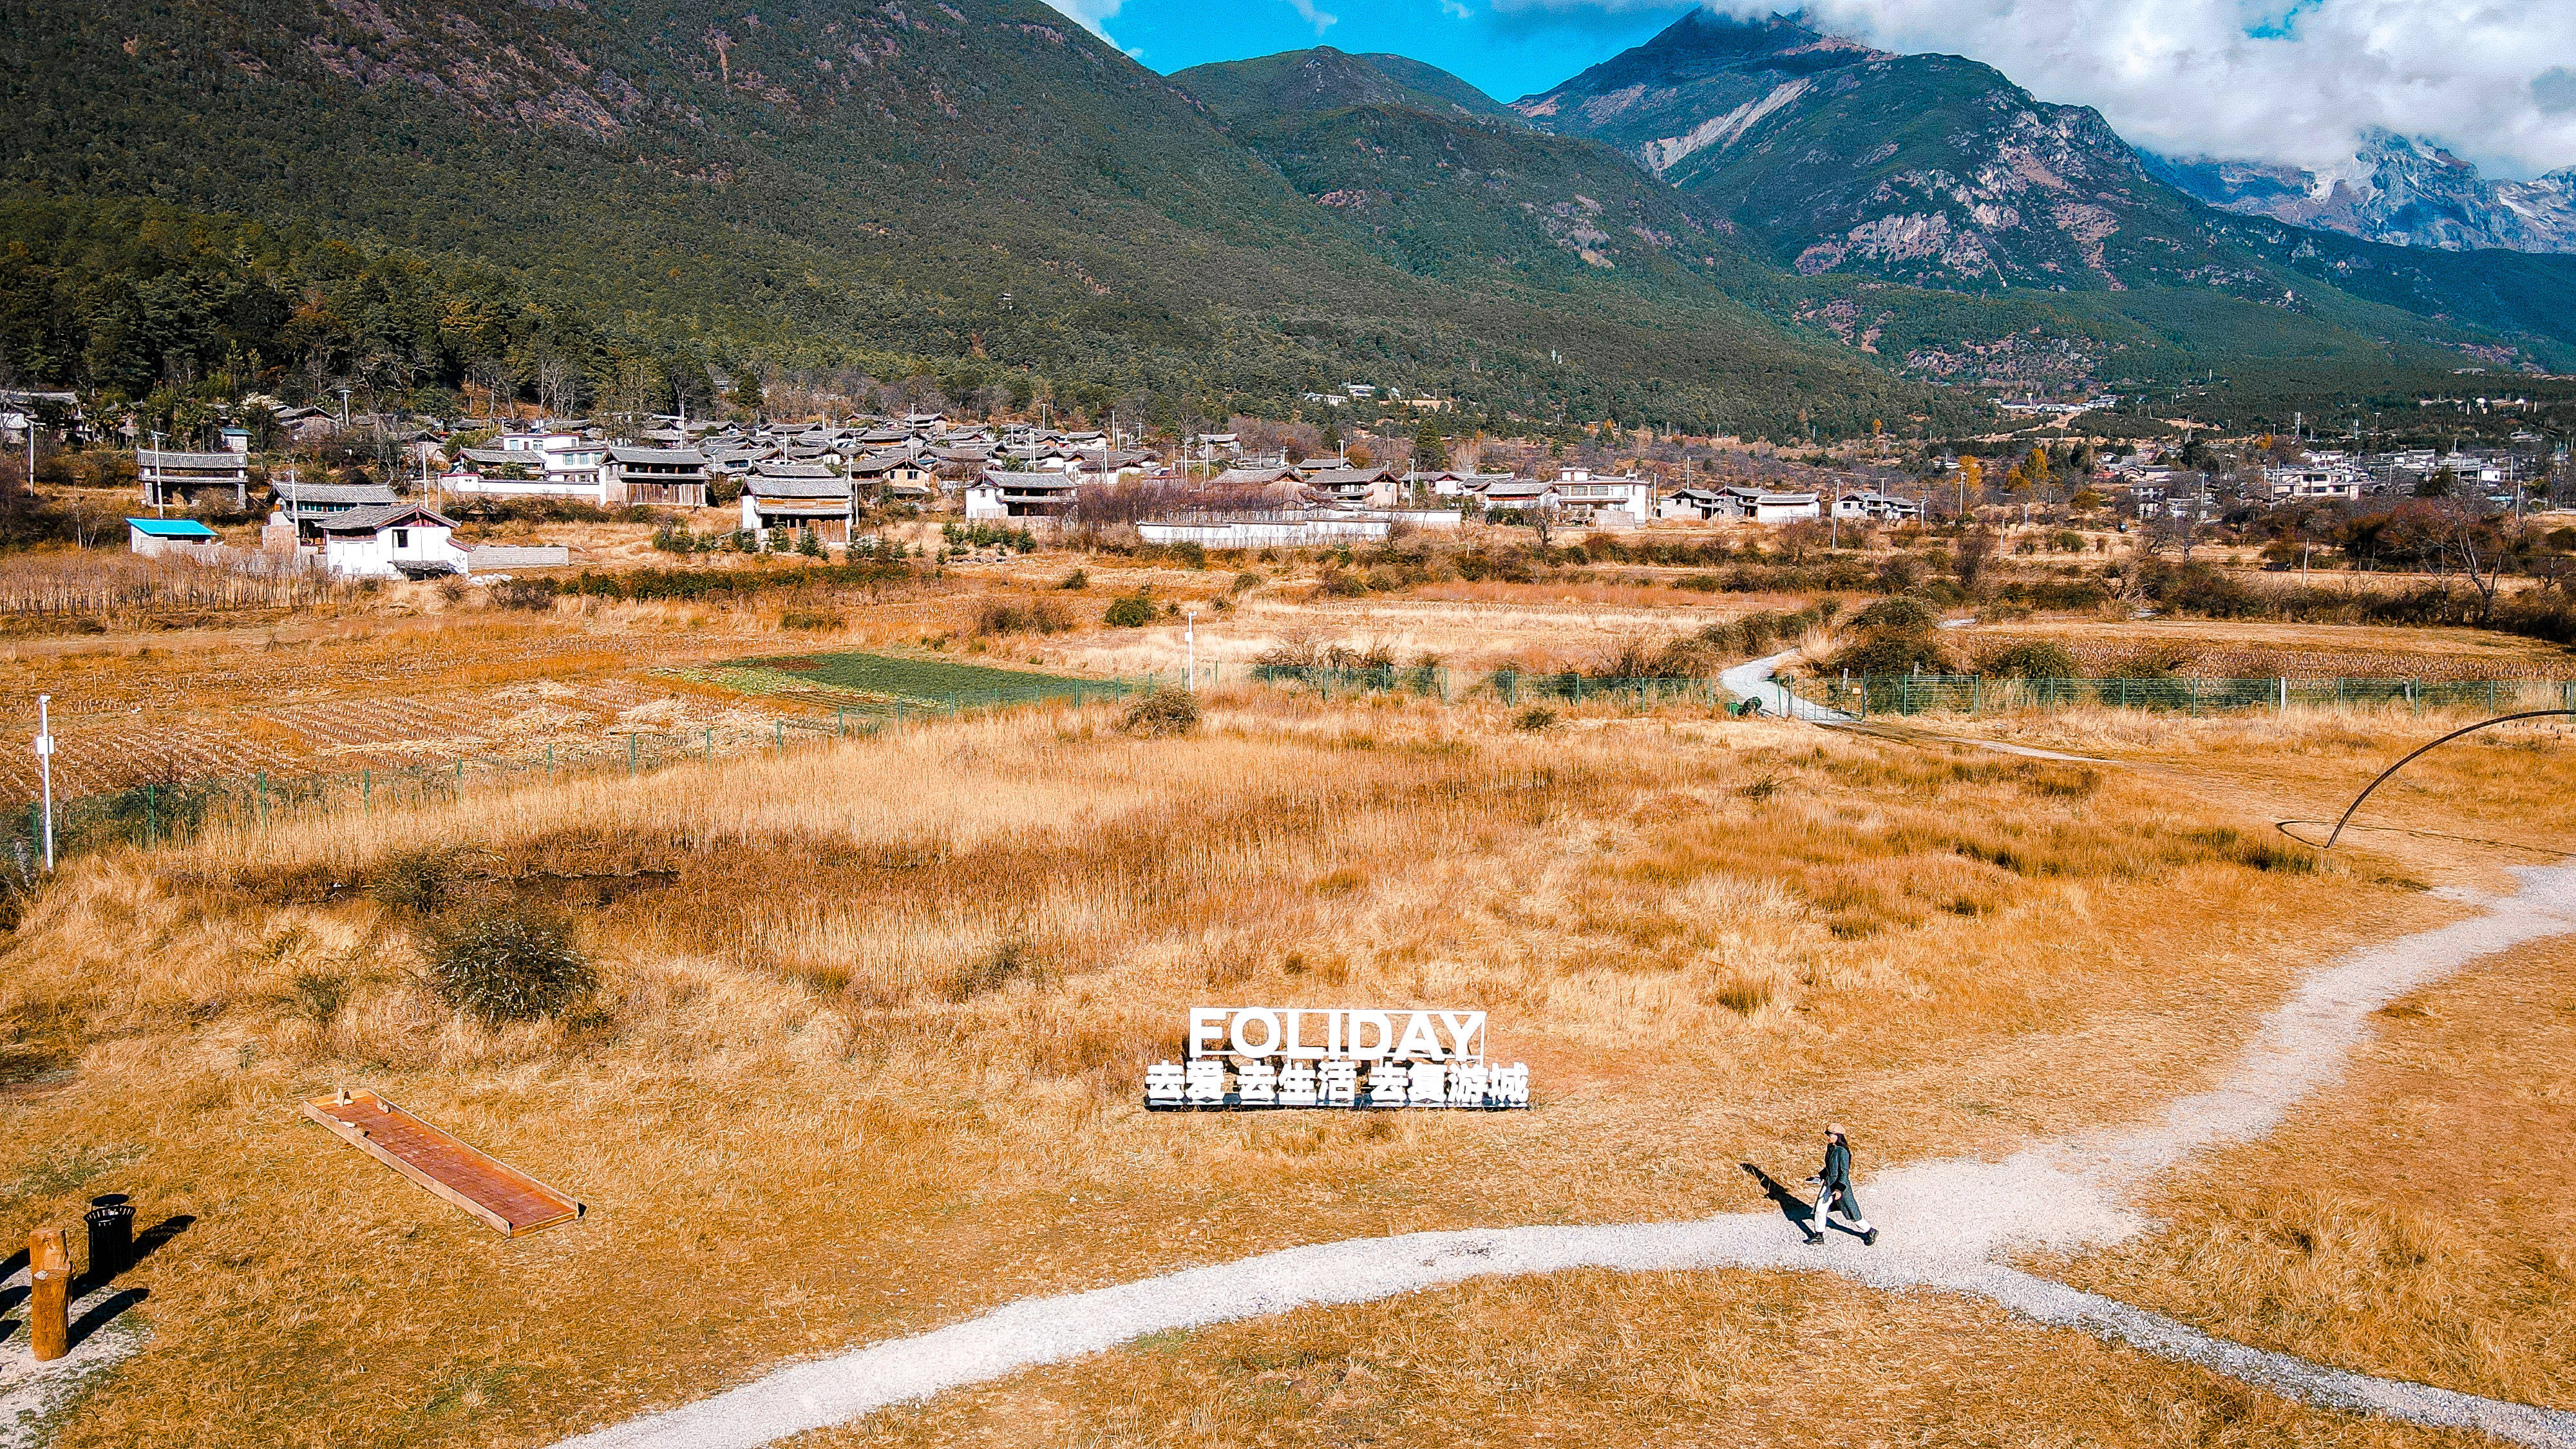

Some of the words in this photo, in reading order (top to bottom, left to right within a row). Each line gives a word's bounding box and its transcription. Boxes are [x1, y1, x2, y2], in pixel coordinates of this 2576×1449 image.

[1190, 1007, 1485, 1061] FOLIDAY
[1236, 1059, 1357, 1101] 去生活
[1368, 1061, 1530, 1103] 去复游城
